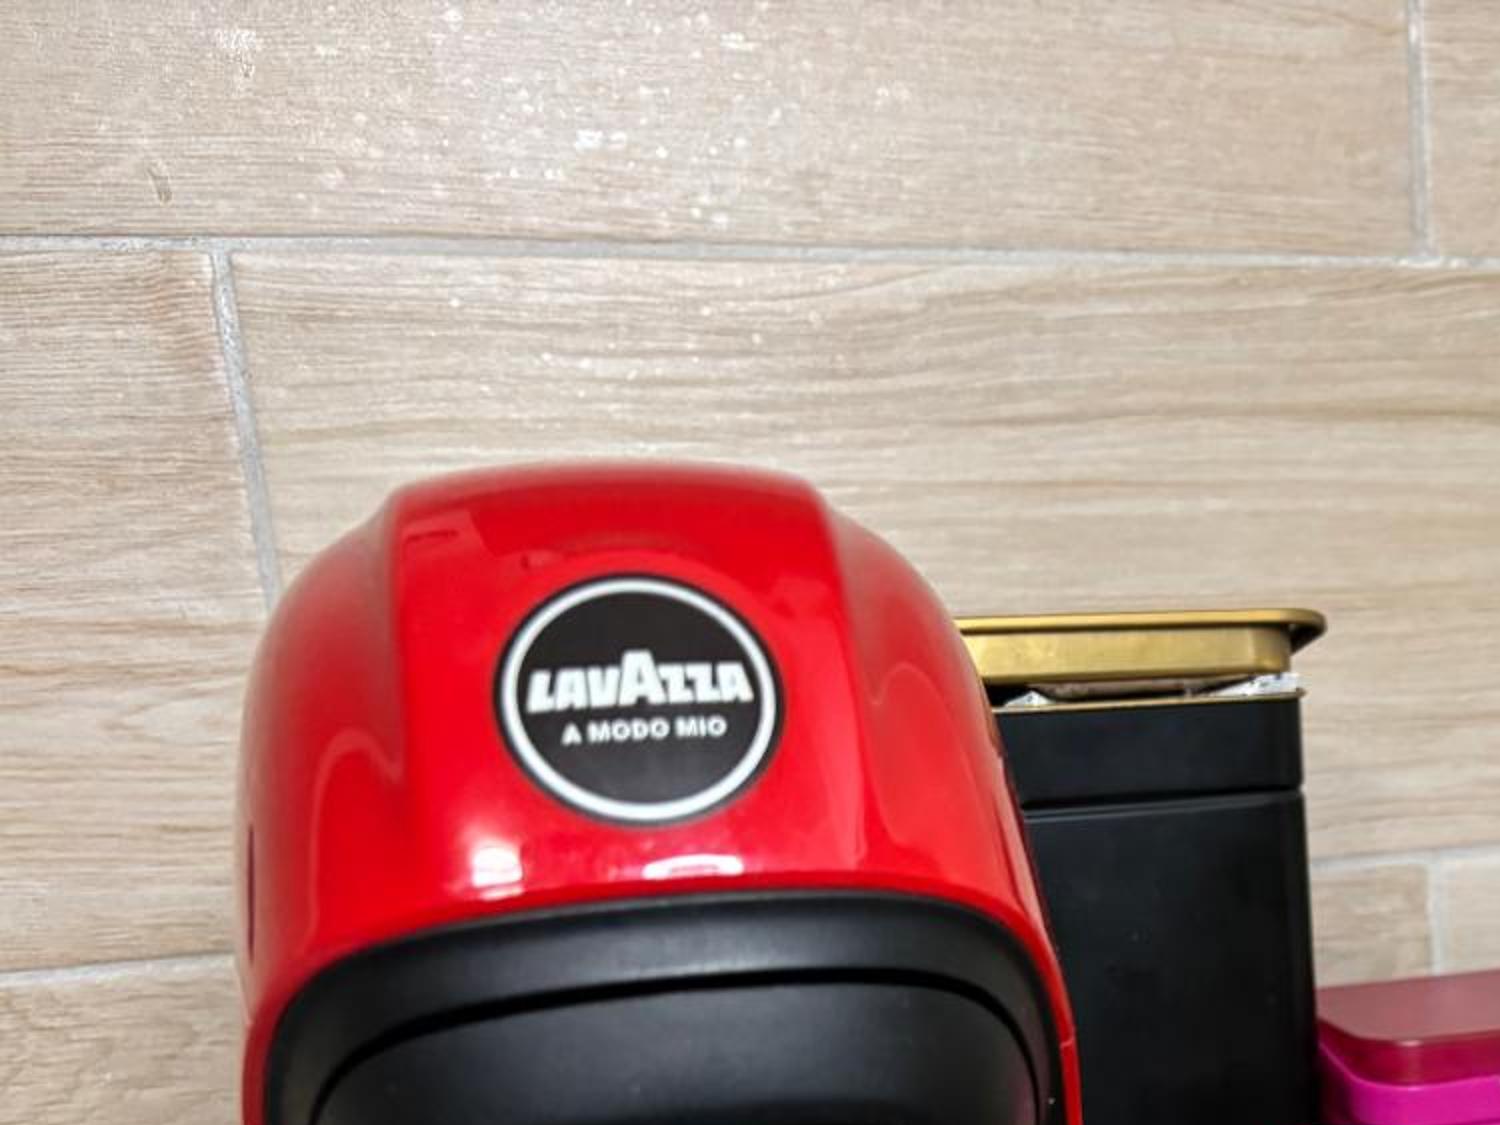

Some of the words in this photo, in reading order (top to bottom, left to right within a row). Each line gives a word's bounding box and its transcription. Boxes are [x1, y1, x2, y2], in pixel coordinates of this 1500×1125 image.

[526, 650, 754, 714] LAVAZZA
[561, 722, 582, 745] A
[586, 717, 671, 743] MODO
[675, 715, 728, 738] MIO
